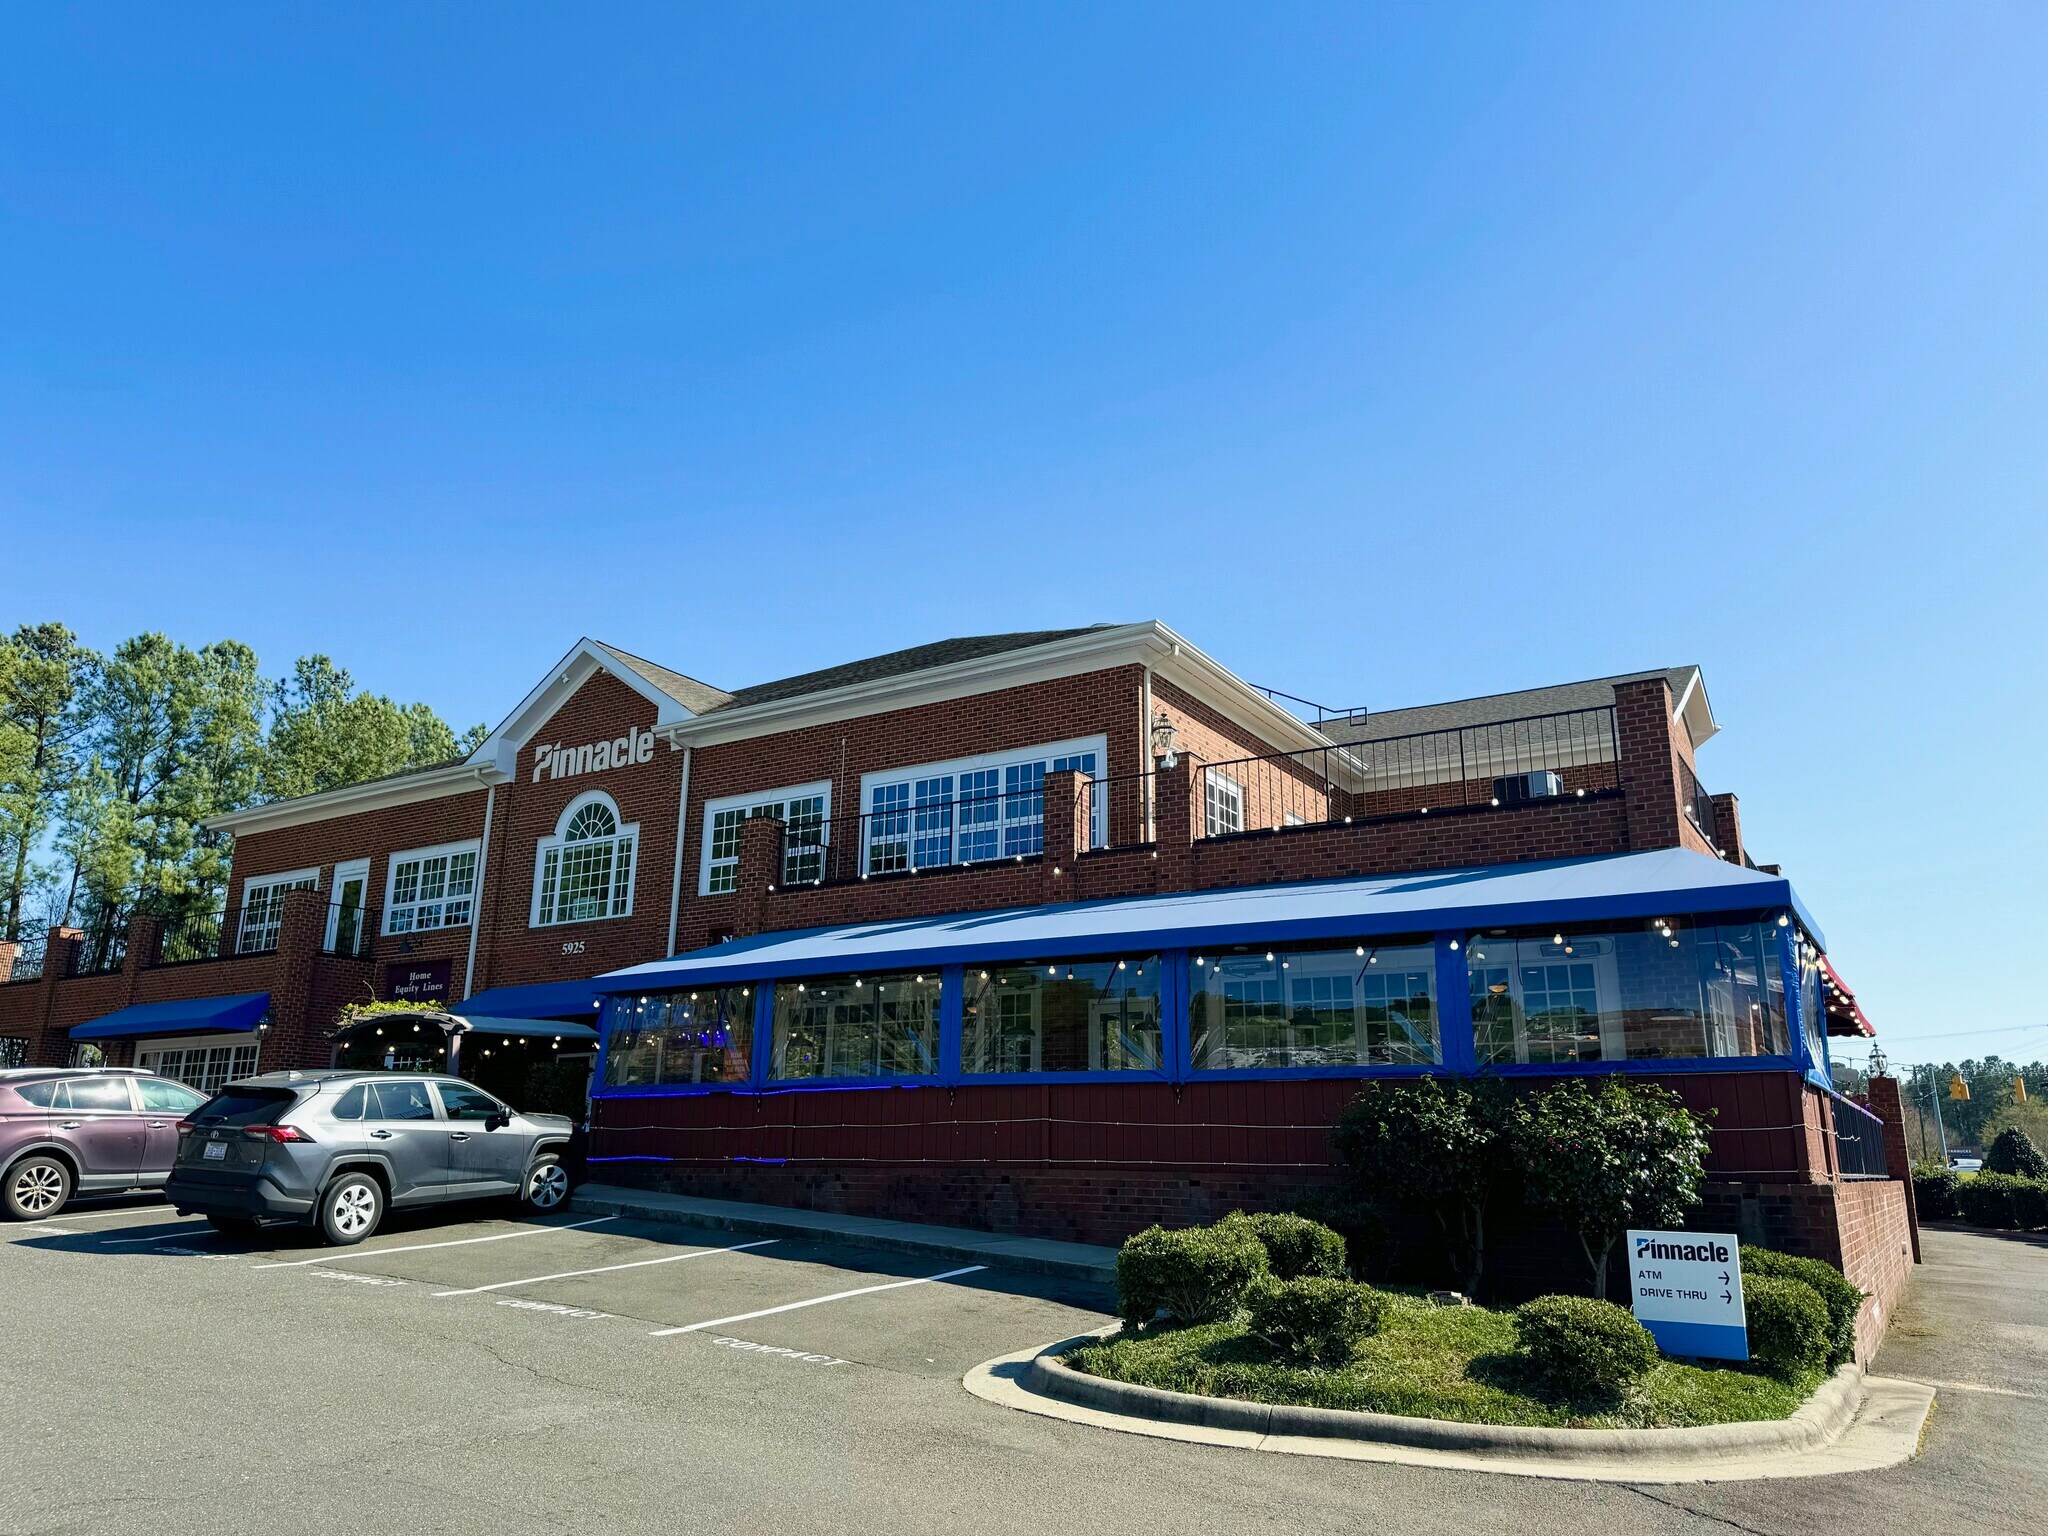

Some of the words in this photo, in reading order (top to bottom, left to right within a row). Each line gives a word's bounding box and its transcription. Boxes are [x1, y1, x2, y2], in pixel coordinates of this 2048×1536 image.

[532, 726, 655, 783] Pinnacle
[561, 941, 586, 956] 5925
[409, 972, 432, 981] Home
[395, 981, 420, 995] Equity
[422, 981, 443, 992] Lines
[1636, 1238, 1729, 1263] Pinnacle
[1639, 1270, 1662, 1280] ATM
[1640, 1287, 1673, 1299] DRIVE
[1676, 1289, 1707, 1300] THRU
[496, 1300, 615, 1320] COMPACT
[712, 1337, 855, 1366] COMPACT
